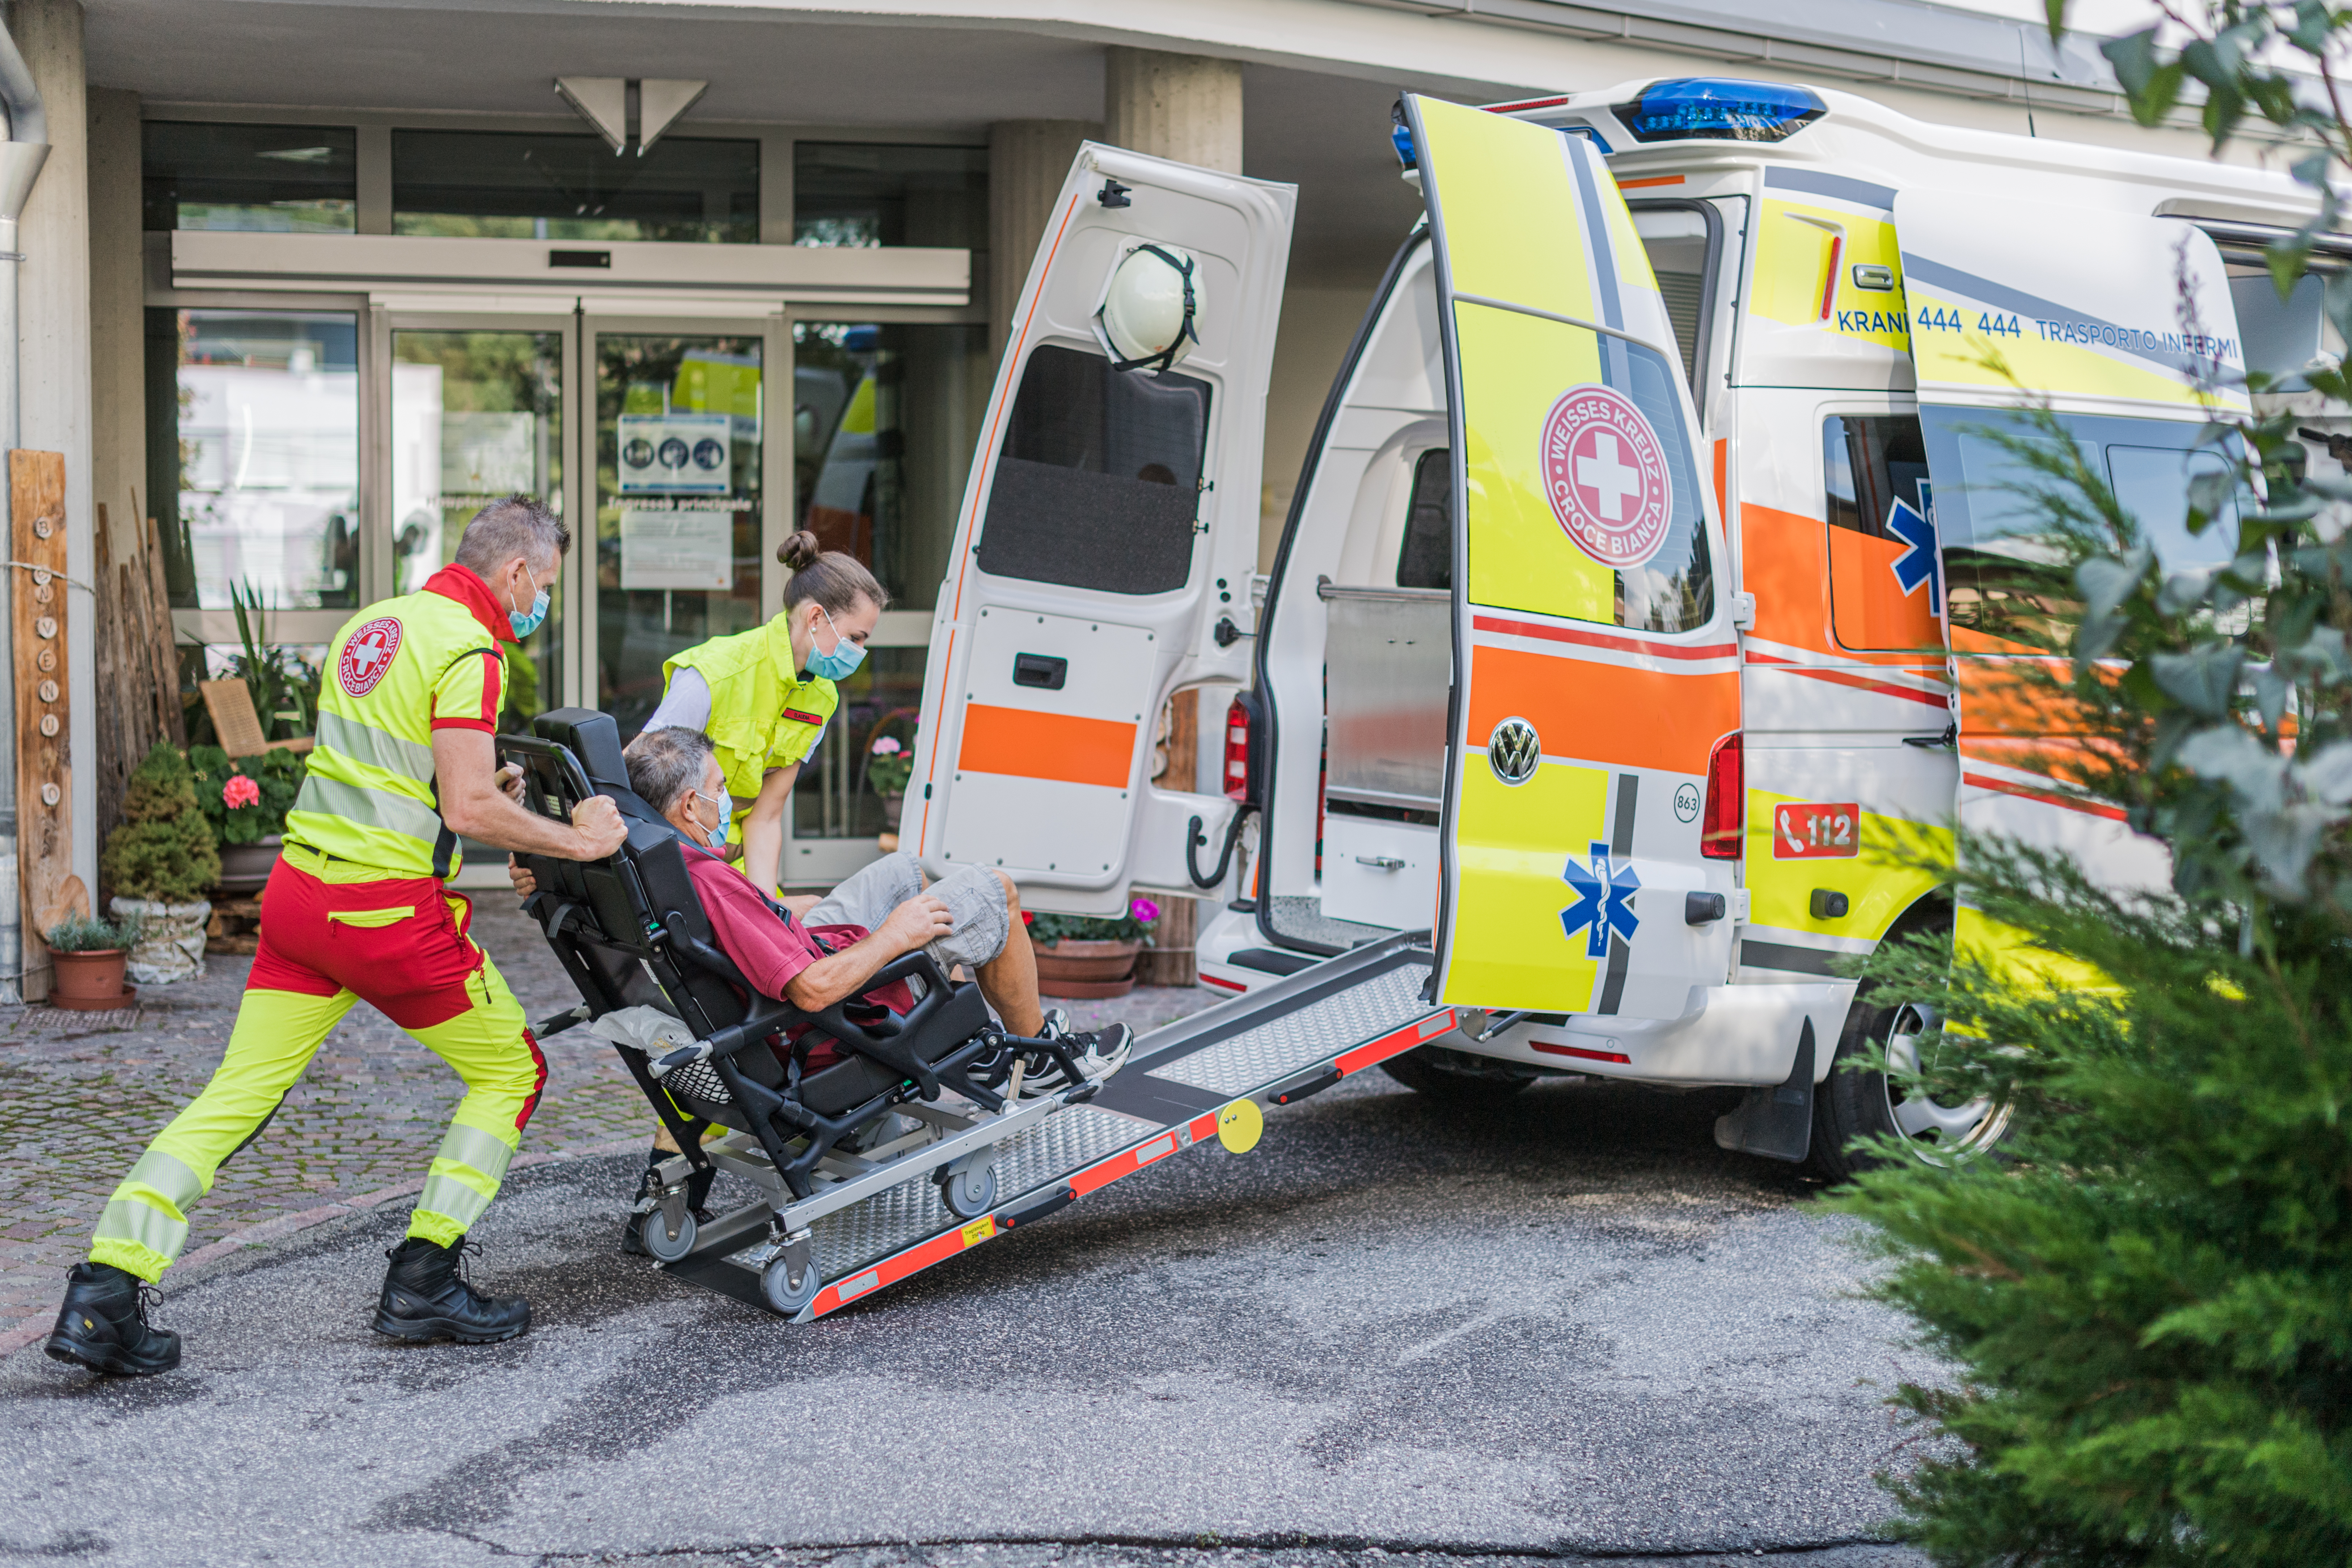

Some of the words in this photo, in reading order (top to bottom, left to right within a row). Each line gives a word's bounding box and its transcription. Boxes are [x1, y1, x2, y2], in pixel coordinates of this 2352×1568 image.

[1918, 307, 1962, 333] 444
[1978, 312, 2021, 338] 444
[2036, 320, 2157, 351] TRASPORTO
[2162, 332, 2238, 358] INFERMI
[1551, 400, 1611, 460] WEISSES
[1613, 408, 1660, 480] KREUZ
[1554, 480, 1607, 551] CROCE
[1611, 502, 1662, 555] BIANCA
[348, 620, 391, 647] WEISSES
[385, 623, 398, 654] KREUZ
[342, 655, 356, 692] CROCE
[354, 664, 385, 693] BIANCA
[794, 712, 810, 721] CLAUDIA
[1678, 795, 1697, 811] 863
[1807, 814, 1851, 846] 112
